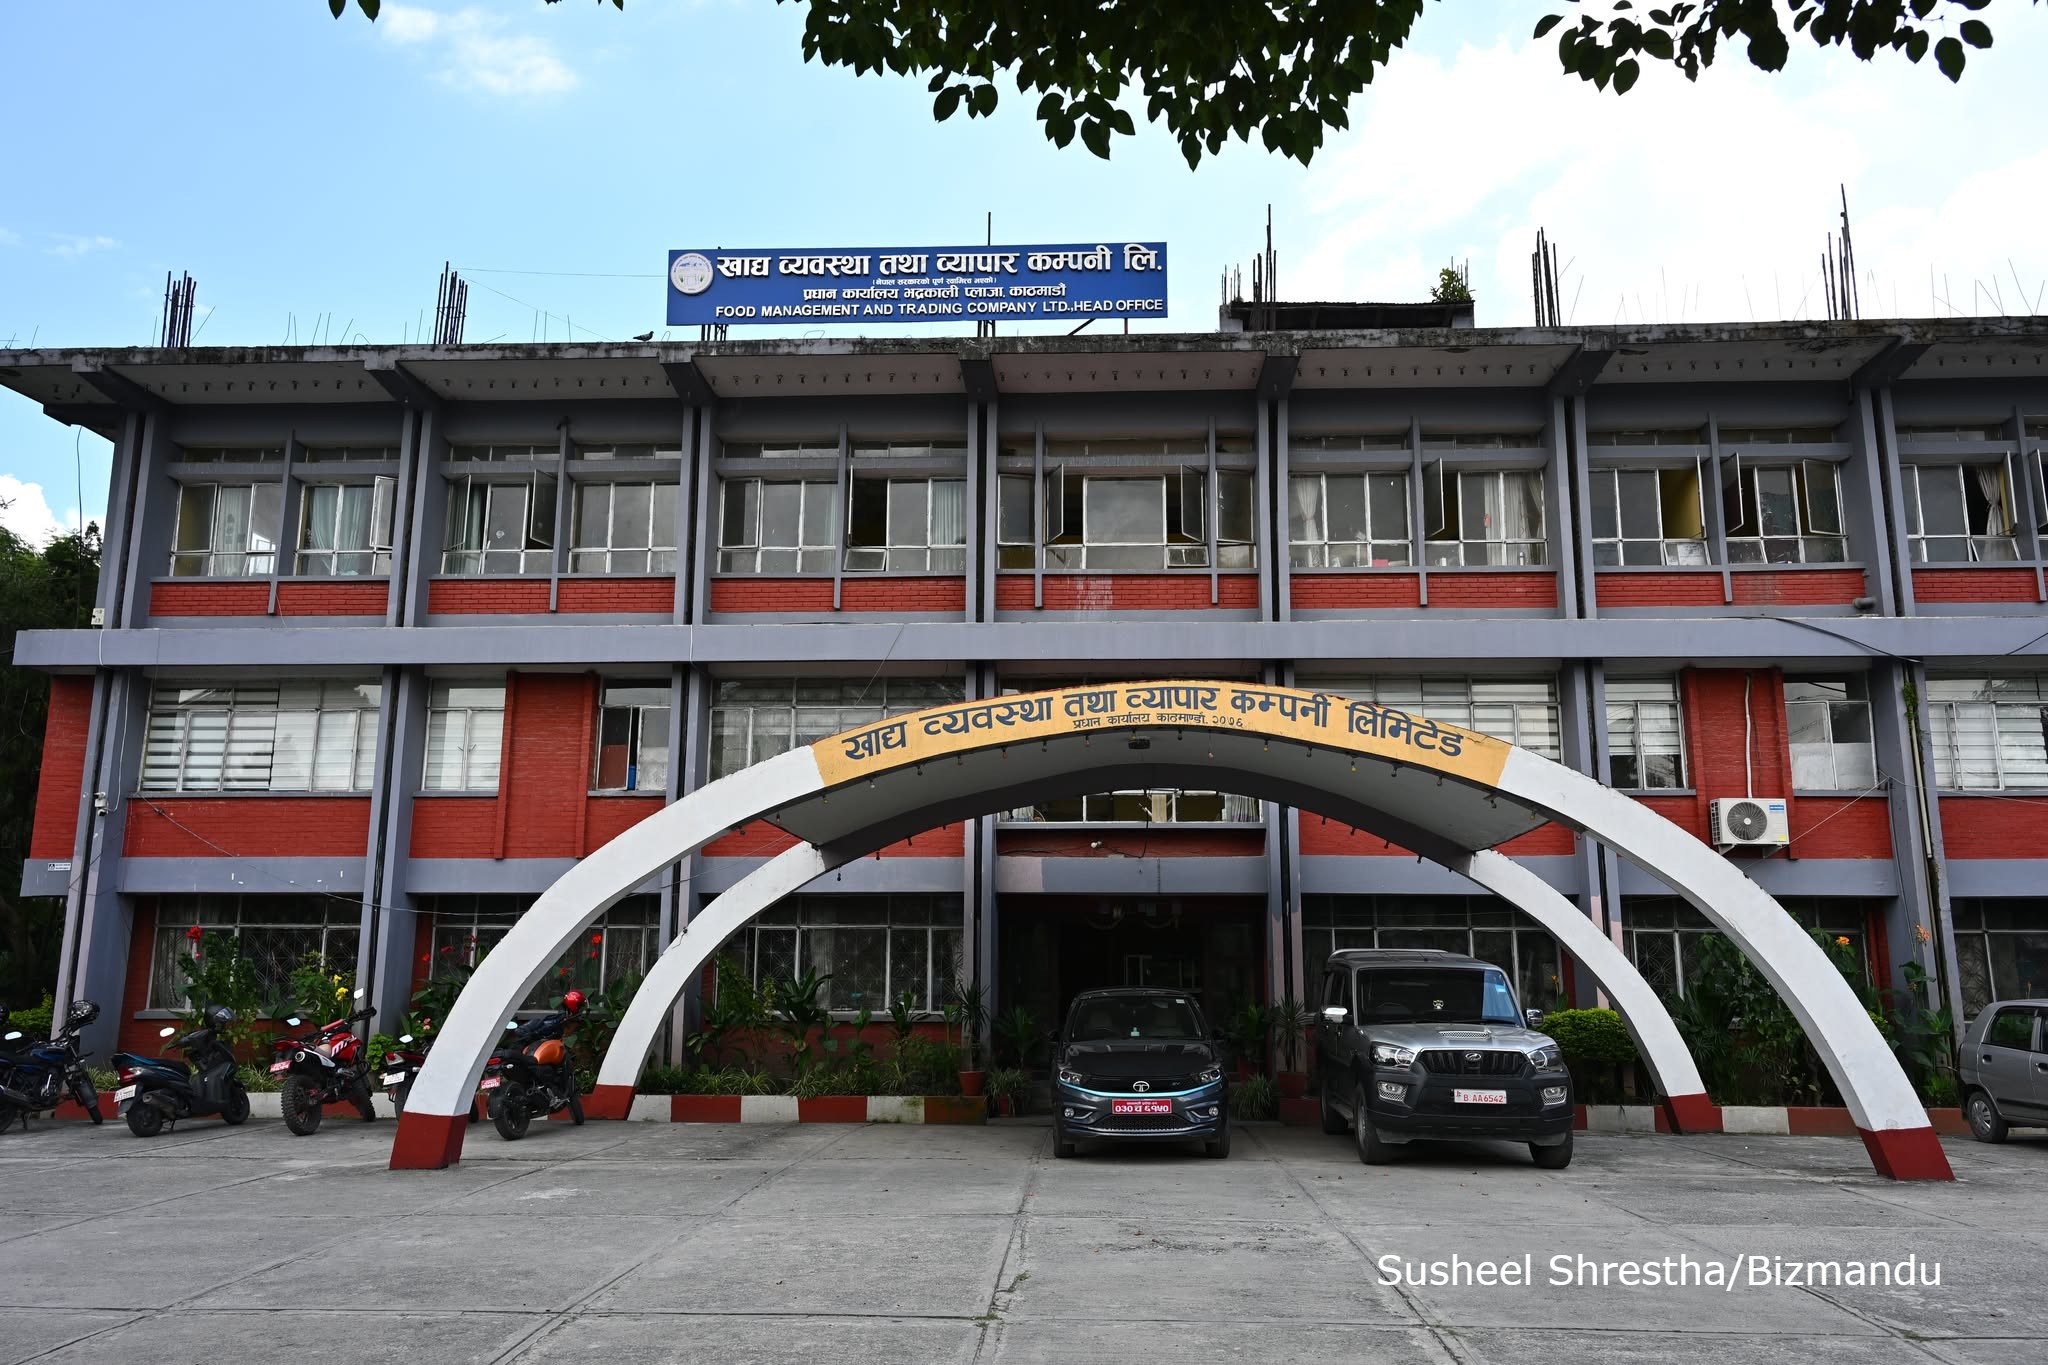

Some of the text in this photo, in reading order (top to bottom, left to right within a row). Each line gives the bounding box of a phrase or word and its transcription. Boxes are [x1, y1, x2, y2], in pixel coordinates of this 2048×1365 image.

[717, 257, 771, 277] खाद्य
[779, 256, 871, 276] व्यवस्था
[880, 255, 928, 275] तथा
[937, 253, 1020, 274] व्यापार
[1028, 244, 1113, 271] कम्पनी
[1124, 243, 1162, 271] लि.
[803, 289, 837, 301] प्रधान
[842, 286, 899, 300] कार्यालय
[904, 284, 959, 300] भद्रकाली
[716, 306, 755, 317] FOOD
[762, 305, 859, 317] MANAGEMENT
[864, 304, 893, 315] AND
[898, 303, 962, 314] TRADING
[968, 302, 1036, 313] COMPANY
[1116, 300, 1162, 311] OFFICE
[841, 686, 1465, 761] खाद्य व्यवस्था तथा व्यापार कम्पनी लिमिटेड
[1073, 716, 1101, 729] प्रधान
[1106, 711, 1151, 725] कार्यालय
